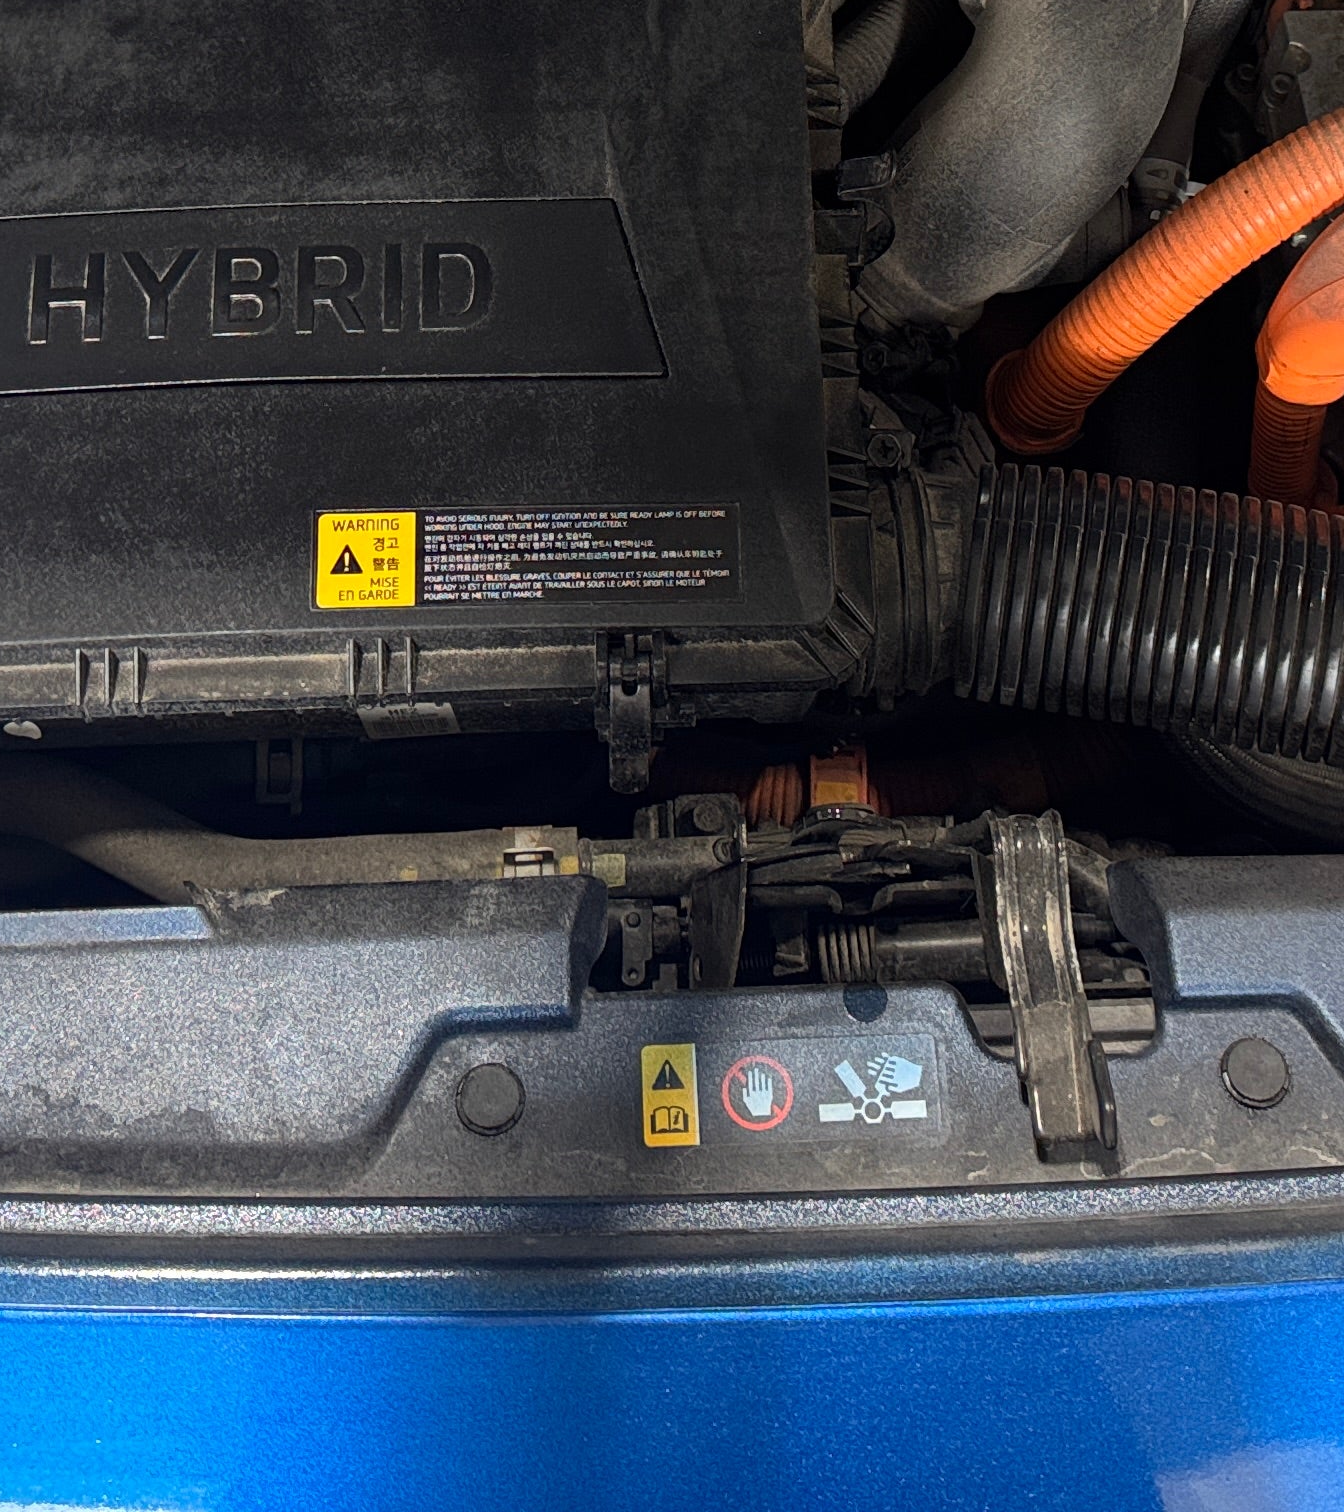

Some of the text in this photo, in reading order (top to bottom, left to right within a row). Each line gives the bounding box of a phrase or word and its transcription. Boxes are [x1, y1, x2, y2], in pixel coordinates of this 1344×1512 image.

[26, 240, 494, 345] HYBRID
[425, 515, 434, 523] TO
[516, 513, 535, 521] TURN
[536, 513, 551, 521] OFF
[552, 512, 581, 520] IGNITION
[583, 512, 597, 520] AND
[630, 511, 652, 519] READY
[683, 510, 697, 518] OFF
[699, 510, 726, 518] BEFORE
[332, 518, 400, 532] WARNING
[551, 521, 572, 529] START
[373, 537, 400, 552] 경고
[373, 557, 400, 571] 警告
[370, 577, 400, 588] MISE
[424, 575, 443, 583] POUR
[472, 574, 485, 582] LES
[553, 572, 581, 580] COUPER
[593, 571, 624, 579] CONTACT
[433, 583, 457, 591] READY
[607, 580, 615, 588] LE
[666, 579, 674, 587] LE
[676, 578, 706, 587] MOTEUR
[338, 589, 399, 601] EN GARDE
[461, 592, 470, 600] SE
[502, 591, 512, 599] EN
